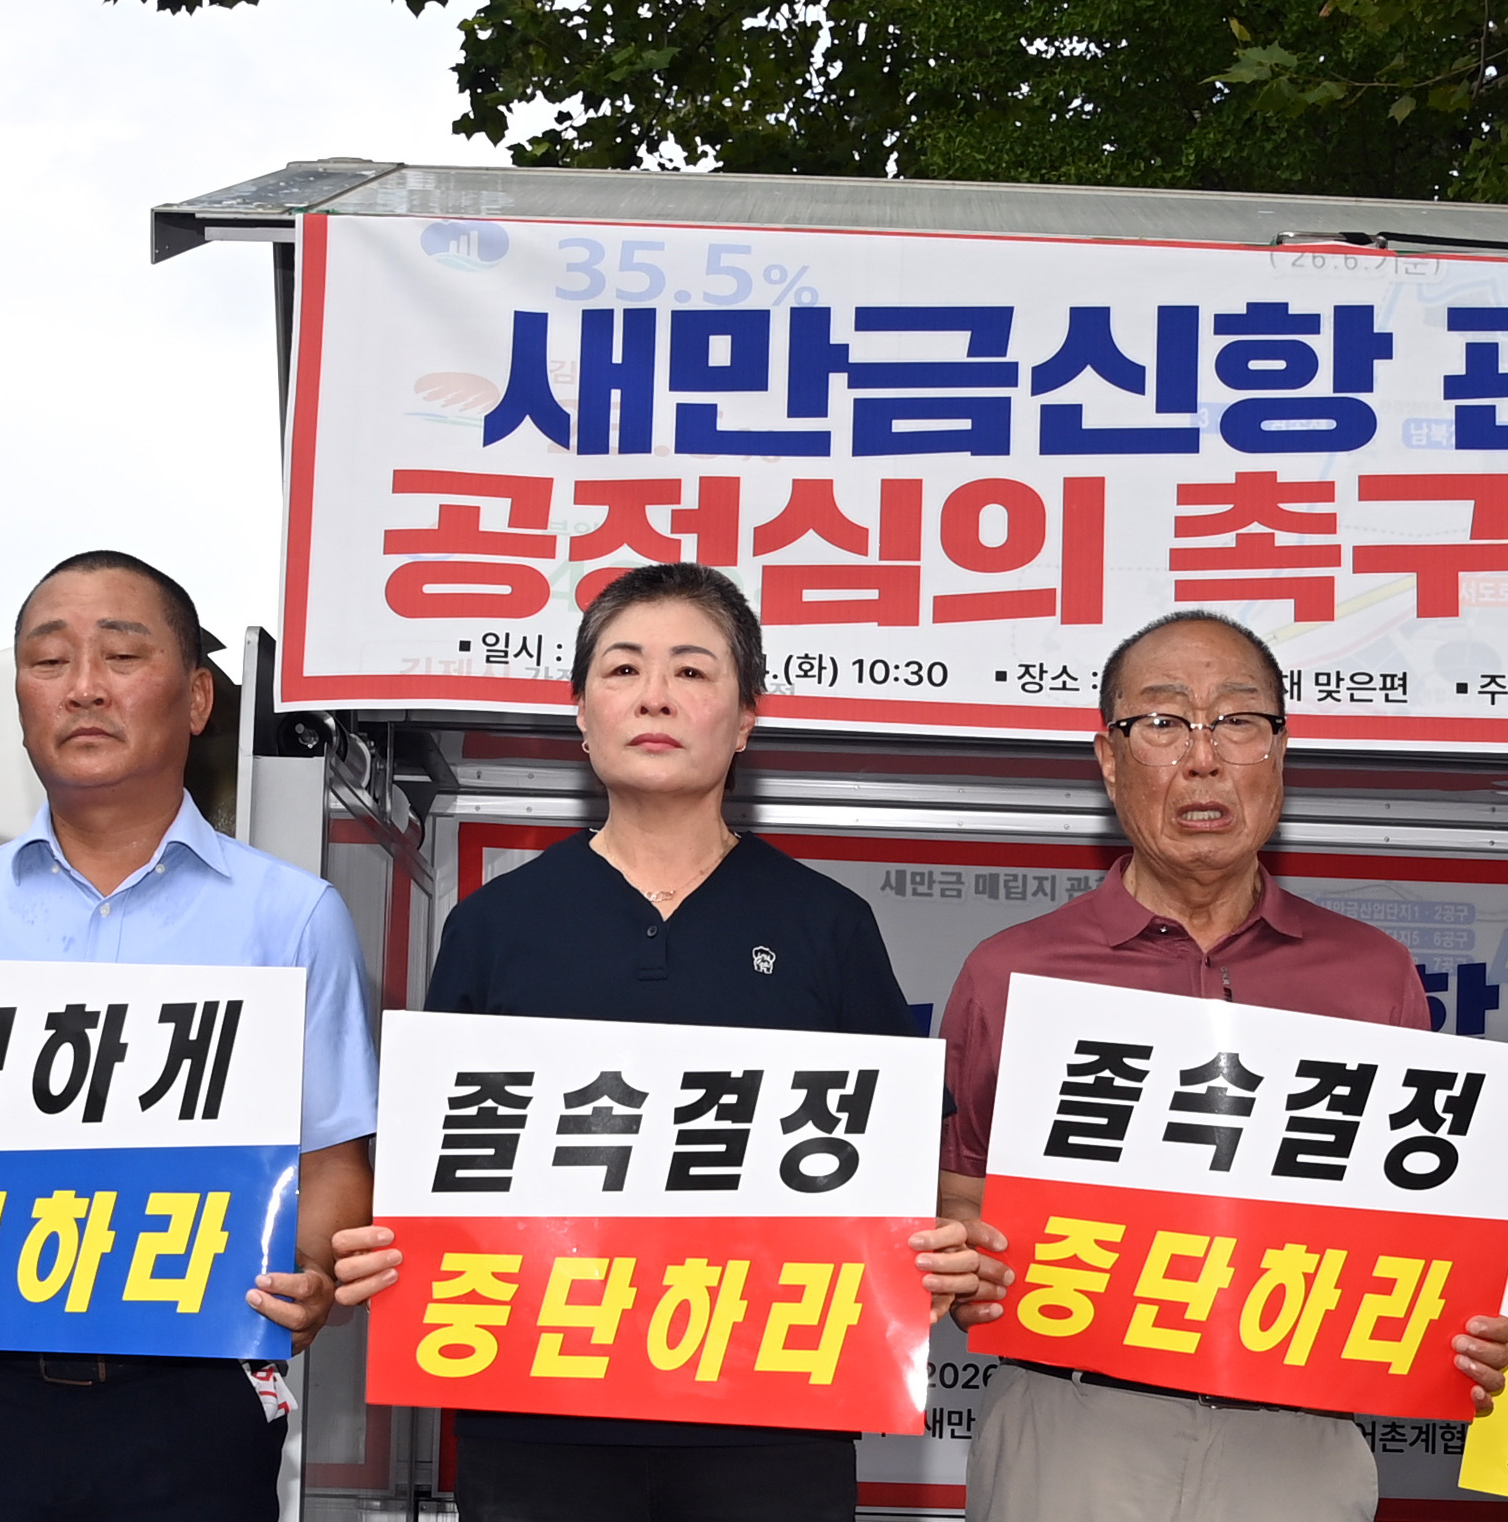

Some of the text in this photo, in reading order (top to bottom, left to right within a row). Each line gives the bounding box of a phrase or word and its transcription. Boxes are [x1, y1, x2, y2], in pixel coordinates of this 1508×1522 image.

[483, 302, 1394, 456] 새만금신항
[481, 631, 543, 668] 일시
[851, 657, 949, 688] 10:30
[1017, 662, 1081, 695] 장소
[1314, 669, 1409, 704] 맞은편
[880, 869, 964, 898] 새만금
[975, 872, 1056, 901] 매립지
[431, 1069, 879, 1194] 졸속결정
[1043, 1039, 1486, 1191] 졸속결정
[416, 1252, 864, 1385] 중단하라
[1017, 1216, 1453, 1375] 중단하라
